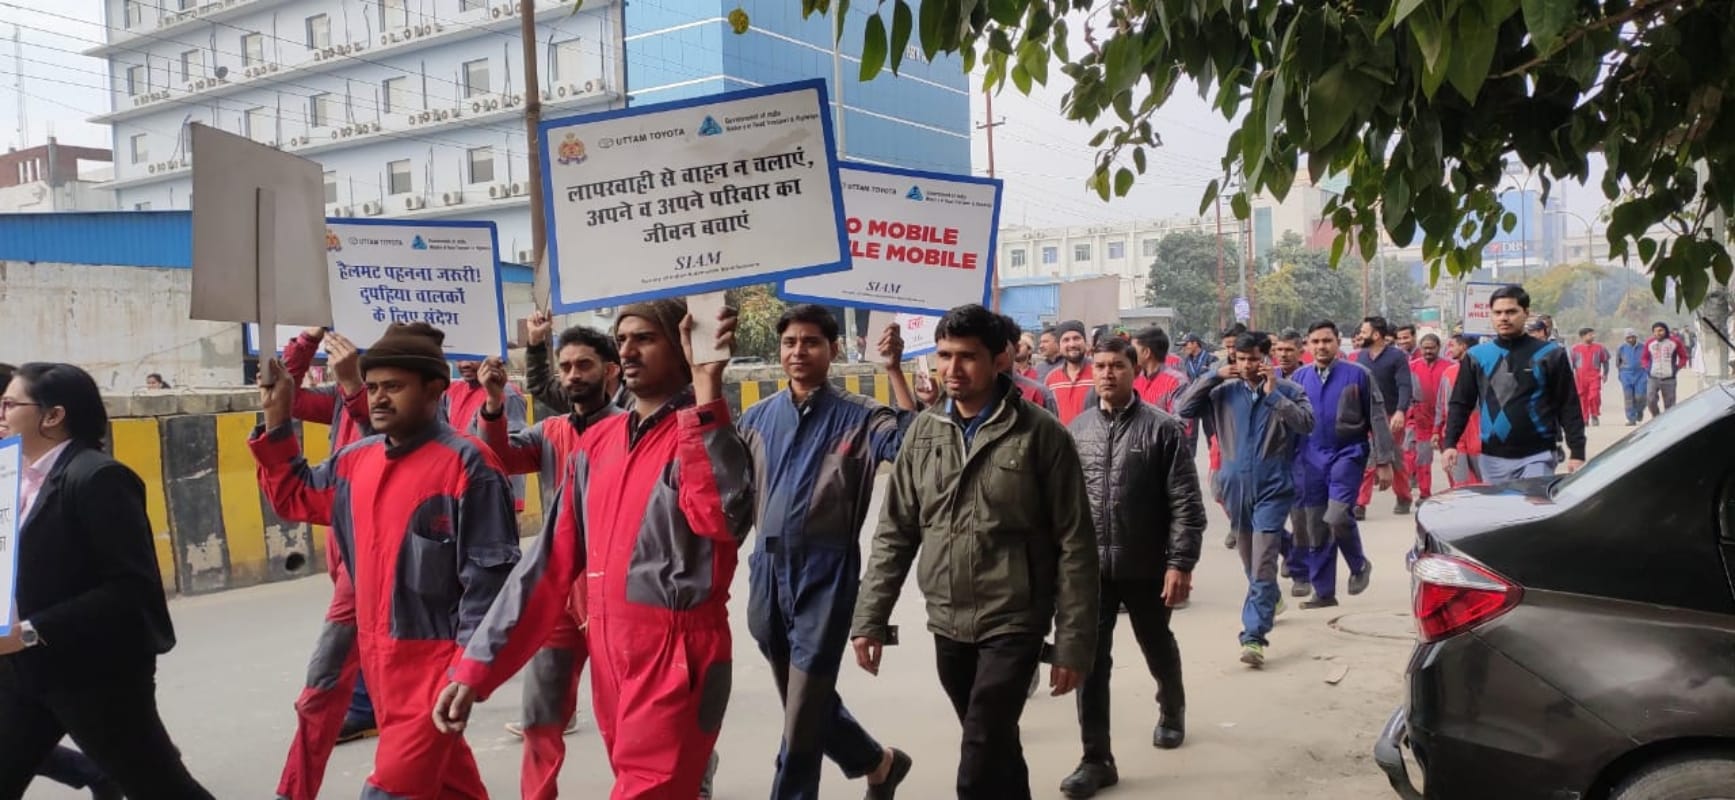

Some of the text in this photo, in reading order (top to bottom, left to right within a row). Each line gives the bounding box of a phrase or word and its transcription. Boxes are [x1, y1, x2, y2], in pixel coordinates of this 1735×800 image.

[616, 128, 686, 146] UTTAM TOYOTA
[566, 146, 814, 202] लापरवाही से वाहन न चलाएं,
[586, 178, 802, 227] अपने व अपने परिवार का
[642, 209, 751, 243] जीवन बचाएं
[846, 217, 959, 245] O MOBILE
[674, 250, 722, 271] SIAM
[886, 244, 978, 270] MOBILE
[384, 265, 432, 283] पहनना
[360, 285, 411, 305] दुपहिया
[865, 281, 901, 293] SIAM
[371, 306, 459, 325] के लिए संदेश
